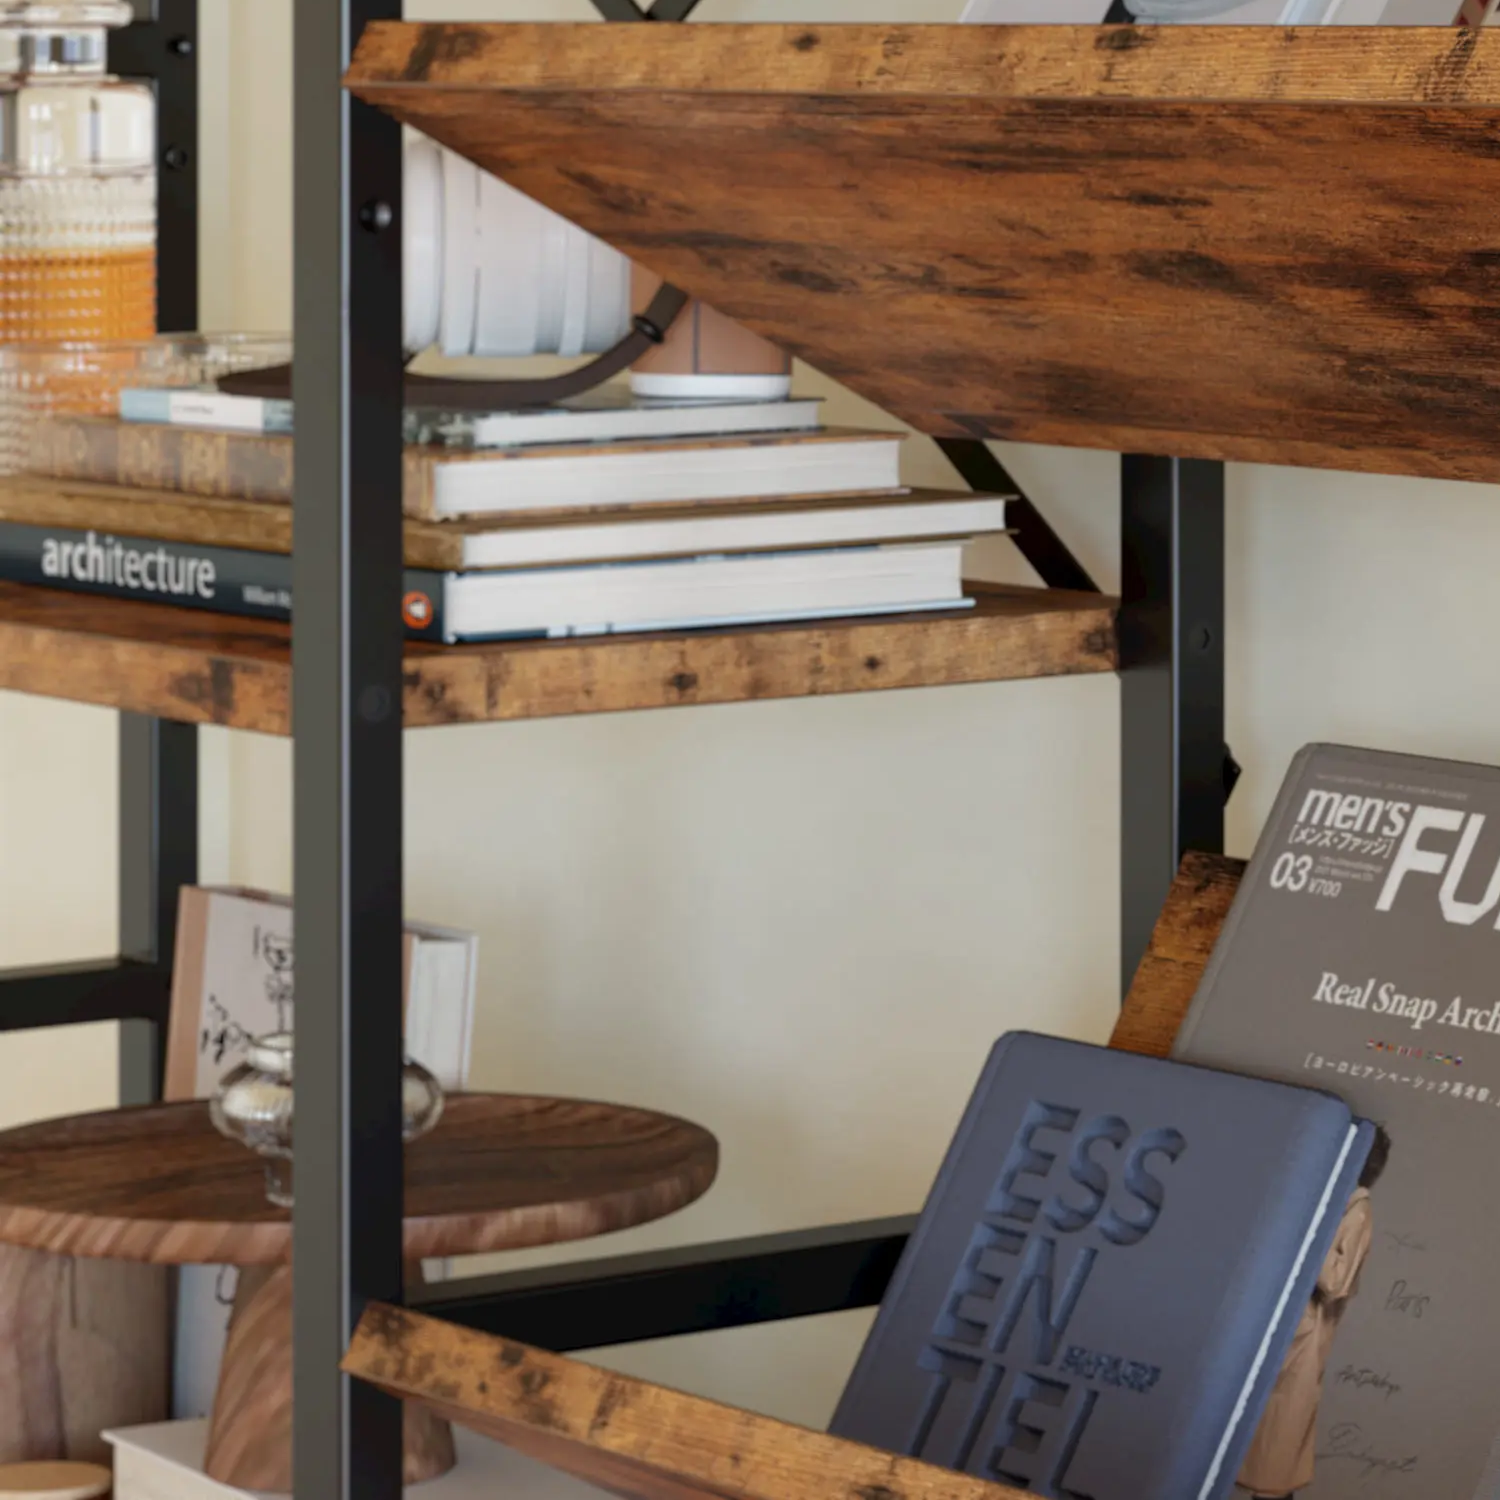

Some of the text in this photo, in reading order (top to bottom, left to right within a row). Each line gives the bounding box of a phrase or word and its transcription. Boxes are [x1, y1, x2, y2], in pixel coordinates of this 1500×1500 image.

[41, 530, 217, 598] architecture
[1297, 788, 1411, 837] men's
[1269, 852, 1313, 891] 03
[1313, 971, 1376, 1010] Real
[1372, 982, 1438, 1030] Snap
[985, 1099, 1187, 1247] ESS
